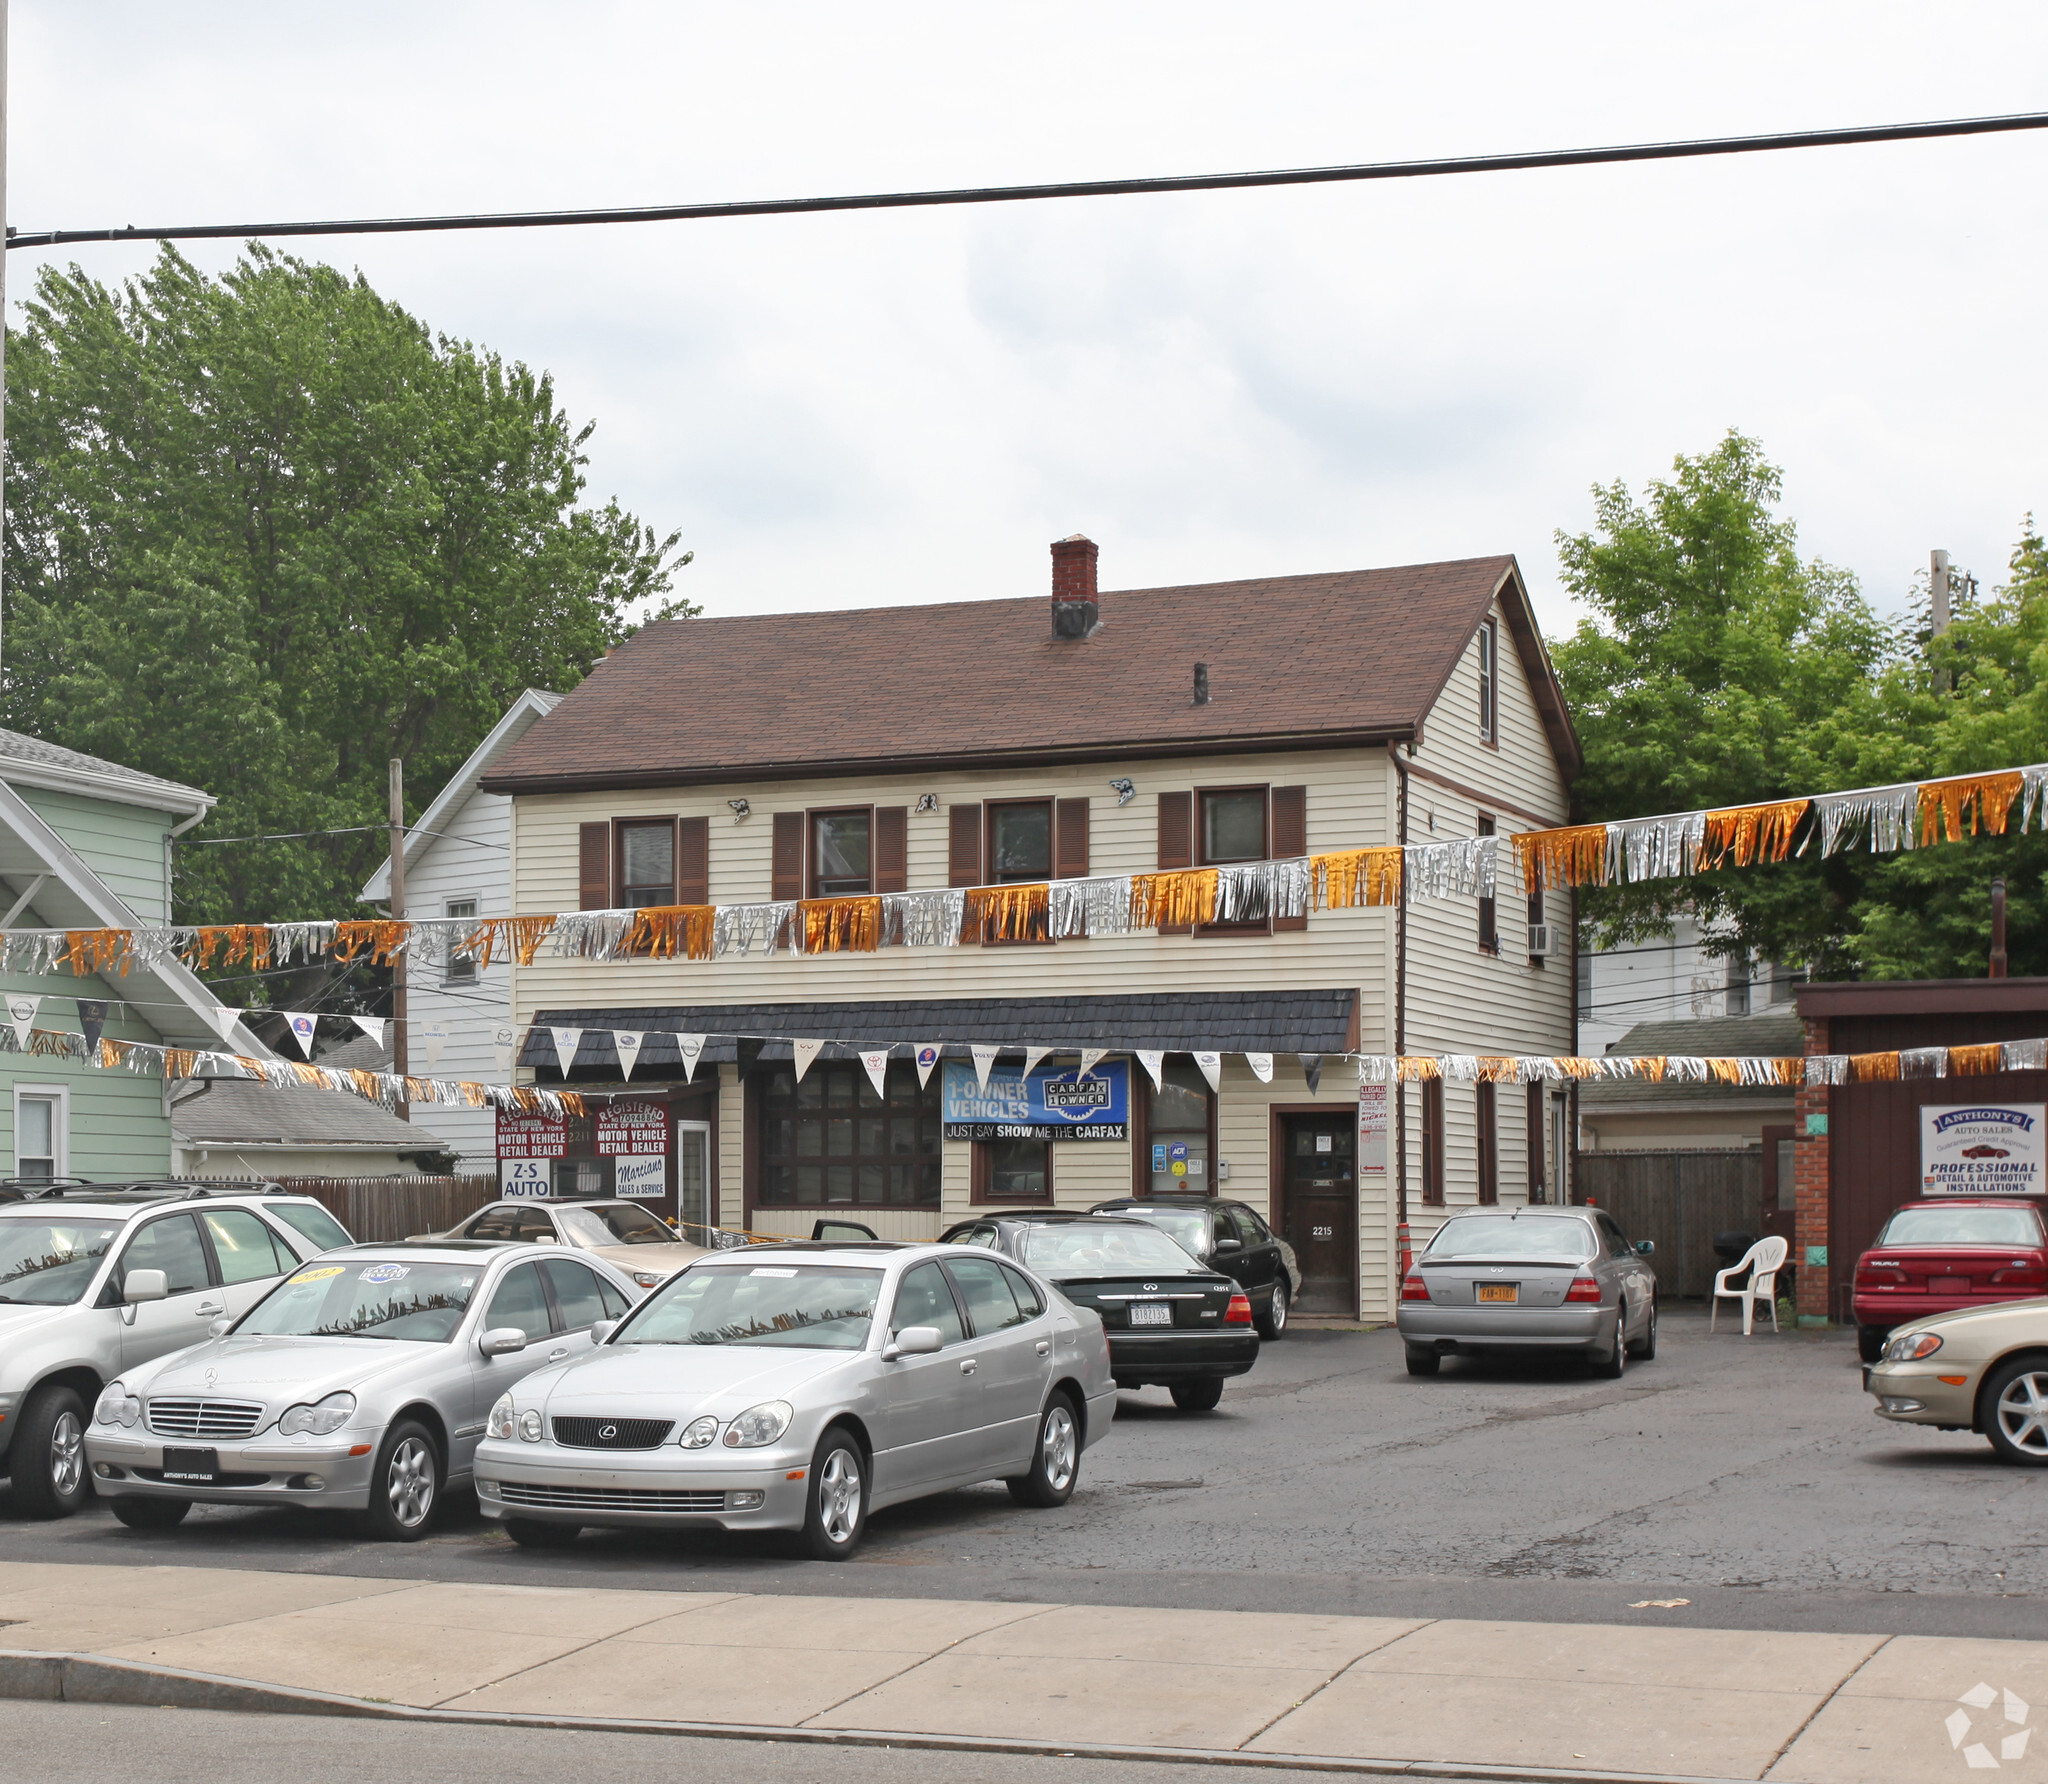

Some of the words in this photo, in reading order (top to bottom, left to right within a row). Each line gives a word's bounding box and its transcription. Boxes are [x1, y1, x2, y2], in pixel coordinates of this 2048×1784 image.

[949, 1081, 1028, 1101] 1-OWNER
[1048, 1083, 1106, 1094] CARFAX
[599, 1101, 664, 1122] REGISTERED
[951, 1100, 1029, 1119] VEHICLES
[1944, 1111, 2022, 1125] ANTHONY'S
[598, 1131, 627, 1141] MOTOR
[631, 1130, 666, 1140] VEHICLE
[948, 1125, 974, 1137] JUST
[976, 1125, 994, 1137] SAY
[997, 1125, 1032, 1137] SHOW
[1035, 1126, 1050, 1138] ME
[1055, 1126, 1073, 1138] THE
[1076, 1125, 1123, 1138] CARFAX
[498, 1134, 527, 1144] MOTOR
[531, 1133, 565, 1143] VEHICLE
[600, 1143, 629, 1153] RETAIL
[632, 1142, 664, 1152] DEALER
[1936, 1137, 1976, 1152] Guaranteed
[2000, 1138, 2031, 1151] Approval
[500, 1146, 529, 1156] RETAIL
[531, 1145, 563, 1155] DEALER
[514, 1163, 537, 1178] Z-S
[618, 1159, 662, 1183] Marciano
[1930, 1163, 2038, 1173] PROFESSIONAL
[1936, 1174, 1964, 1182] DETAIL
[1969, 1174, 1974, 1182] &
[504, 1181, 548, 1195] AUTO
[618, 1184, 635, 1193] SALES
[636, 1185, 640, 1193] &
[641, 1184, 663, 1193] SERVICE
[1947, 1183, 2026, 1191] INSTALLATIONS
[1313, 1227, 1332, 1235] 2215
[1134, 1310, 1166, 1319] 8182135
